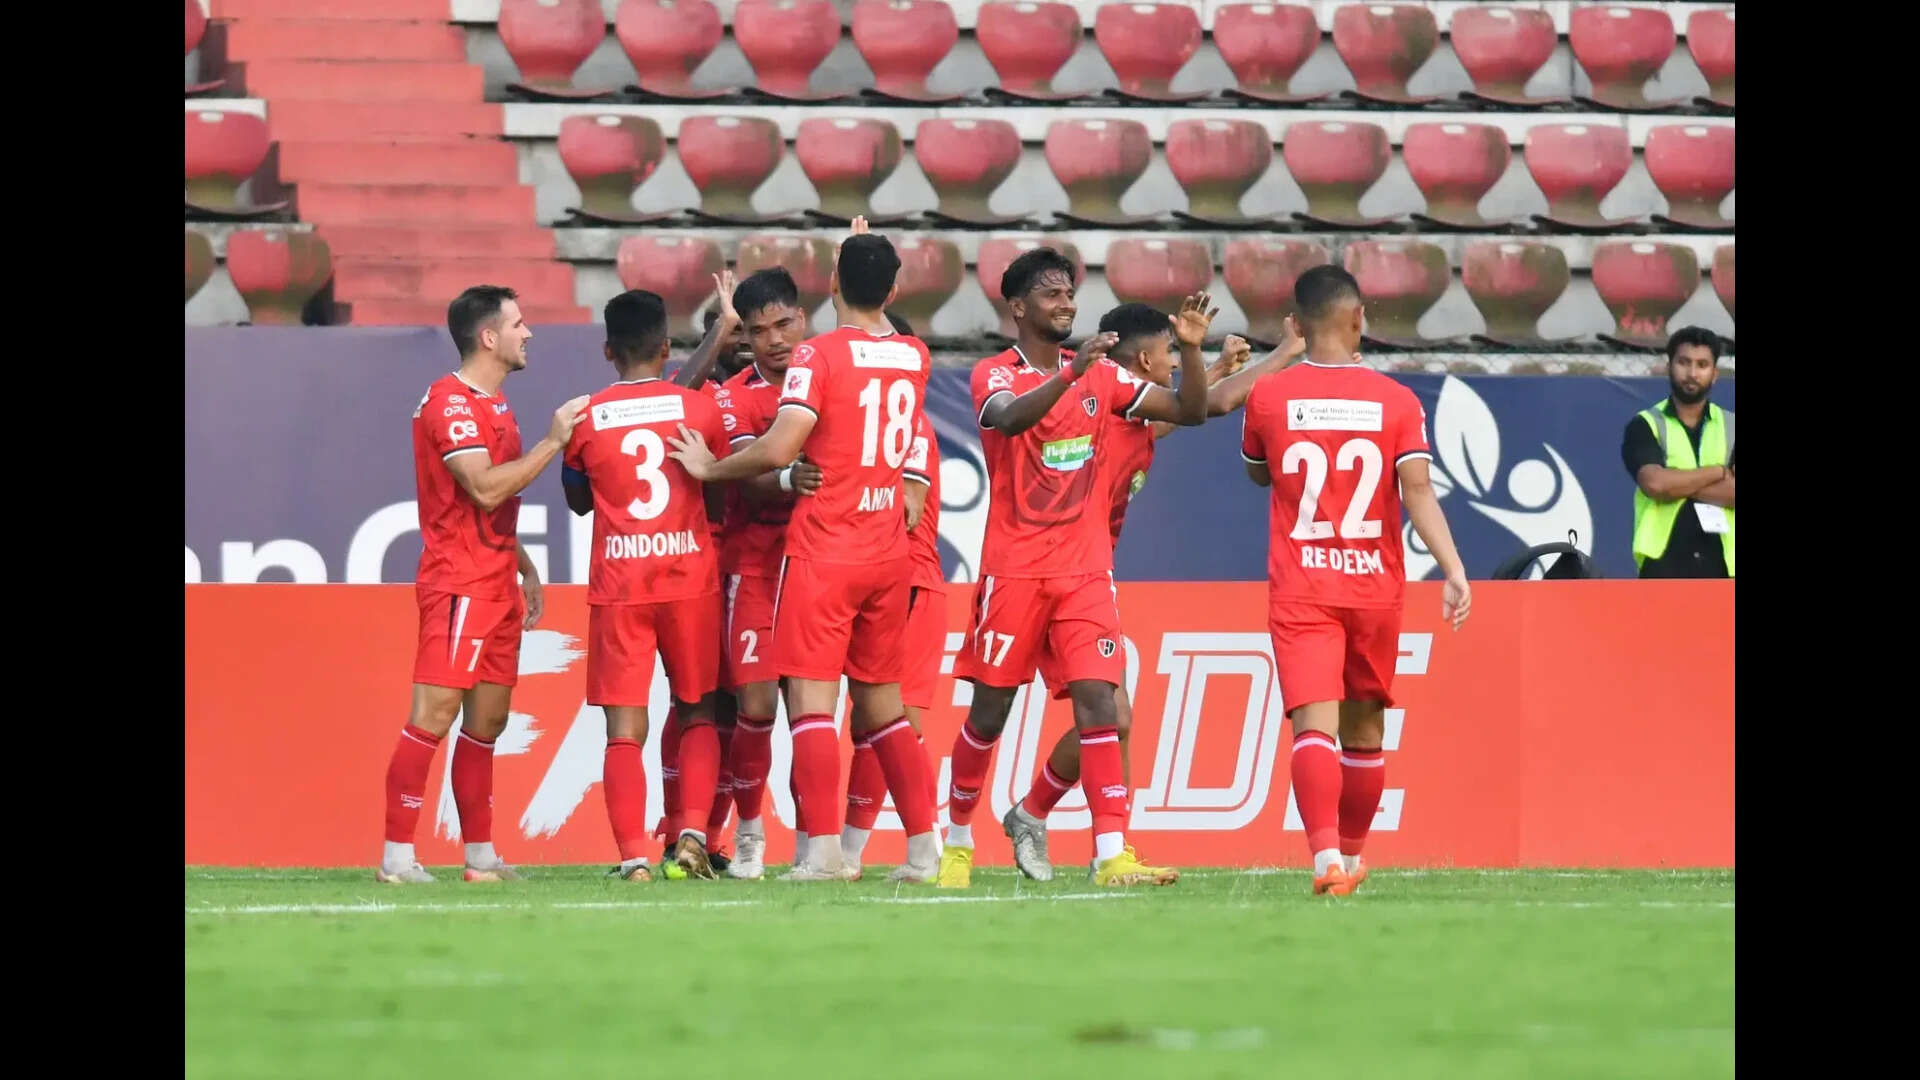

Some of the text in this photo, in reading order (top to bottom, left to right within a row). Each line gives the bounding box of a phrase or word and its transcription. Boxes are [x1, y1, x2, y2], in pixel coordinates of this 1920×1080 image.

[859, 378, 915, 469] 18
[621, 428, 670, 520] 3
[1282, 438, 1383, 540] 22
[1301, 546, 1384, 574] REDEEM
[467, 638, 484, 672] 7
[740, 629, 759, 664] 2
[983, 630, 1015, 667] 17
